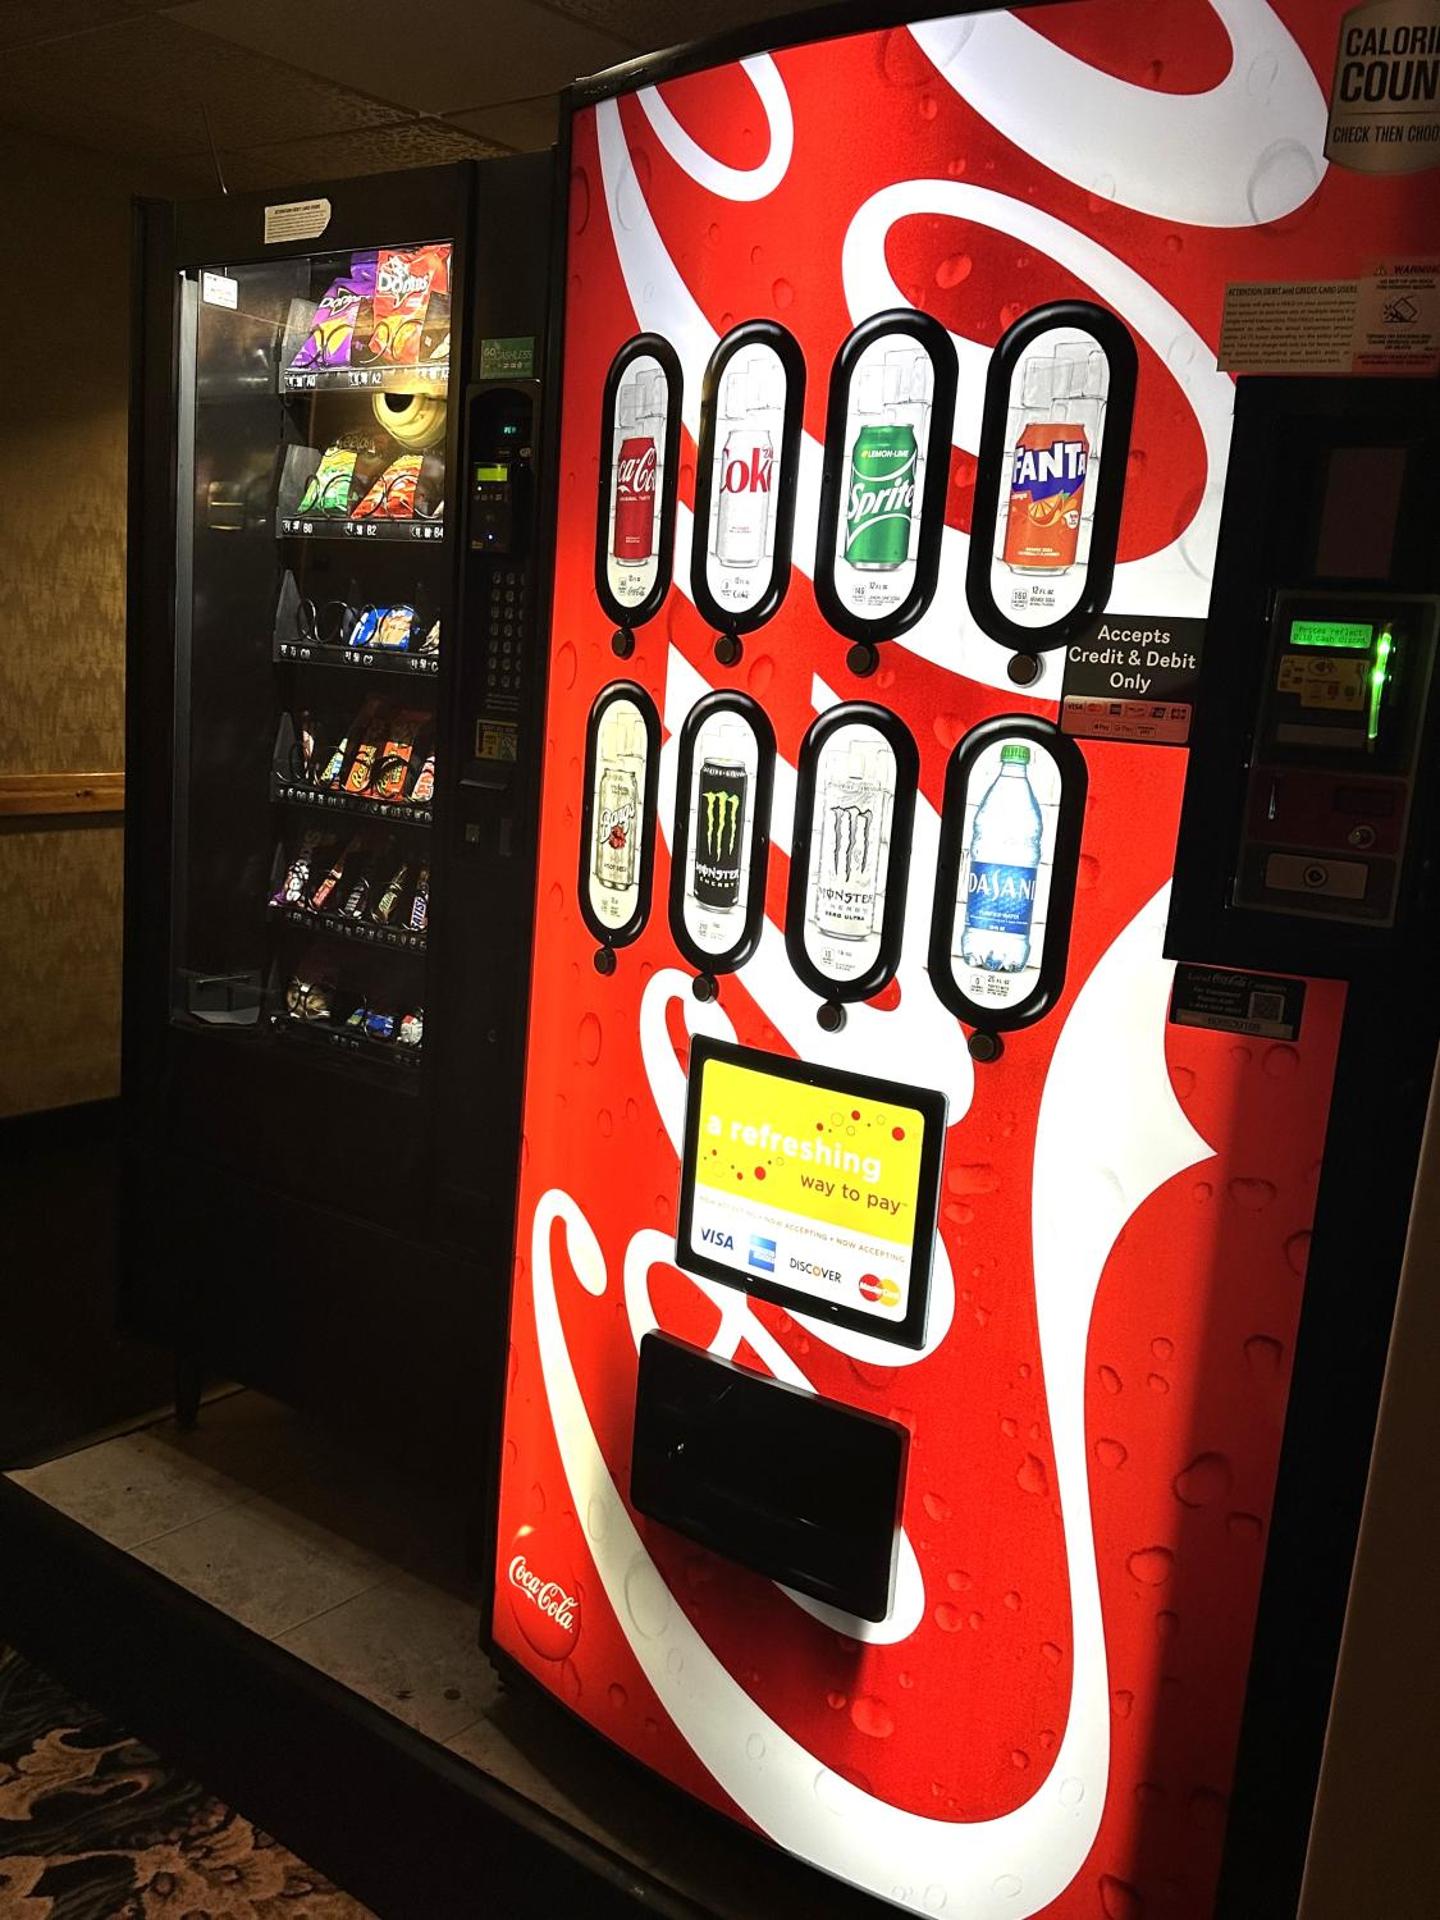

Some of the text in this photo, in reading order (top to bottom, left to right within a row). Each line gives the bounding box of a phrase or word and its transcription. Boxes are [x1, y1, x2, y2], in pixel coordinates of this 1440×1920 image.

[1333, 126, 1371, 144] CHECK
[1375, 125, 1402, 143] THEN
[868, 450, 910, 459] LEMON-LIME
[1098, 625, 1171, 647] Accepts
[1068, 646, 1197, 669] Credit & Debit
[1109, 671, 1152, 694] Only
[968, 869, 1036, 901] DASANI
[707, 1114, 882, 1184] a refreshing
[801, 1173, 901, 1216] way to pay
[701, 1226, 735, 1251] VISA
[784, 1223, 828, 1242] ACCEPTING
[836, 1237, 856, 1250] NOW
[859, 1244, 906, 1264] ACCEPTING
[789, 1257, 843, 1285] DISCOVER
[509, 1555, 579, 1630] Coca-Cola
